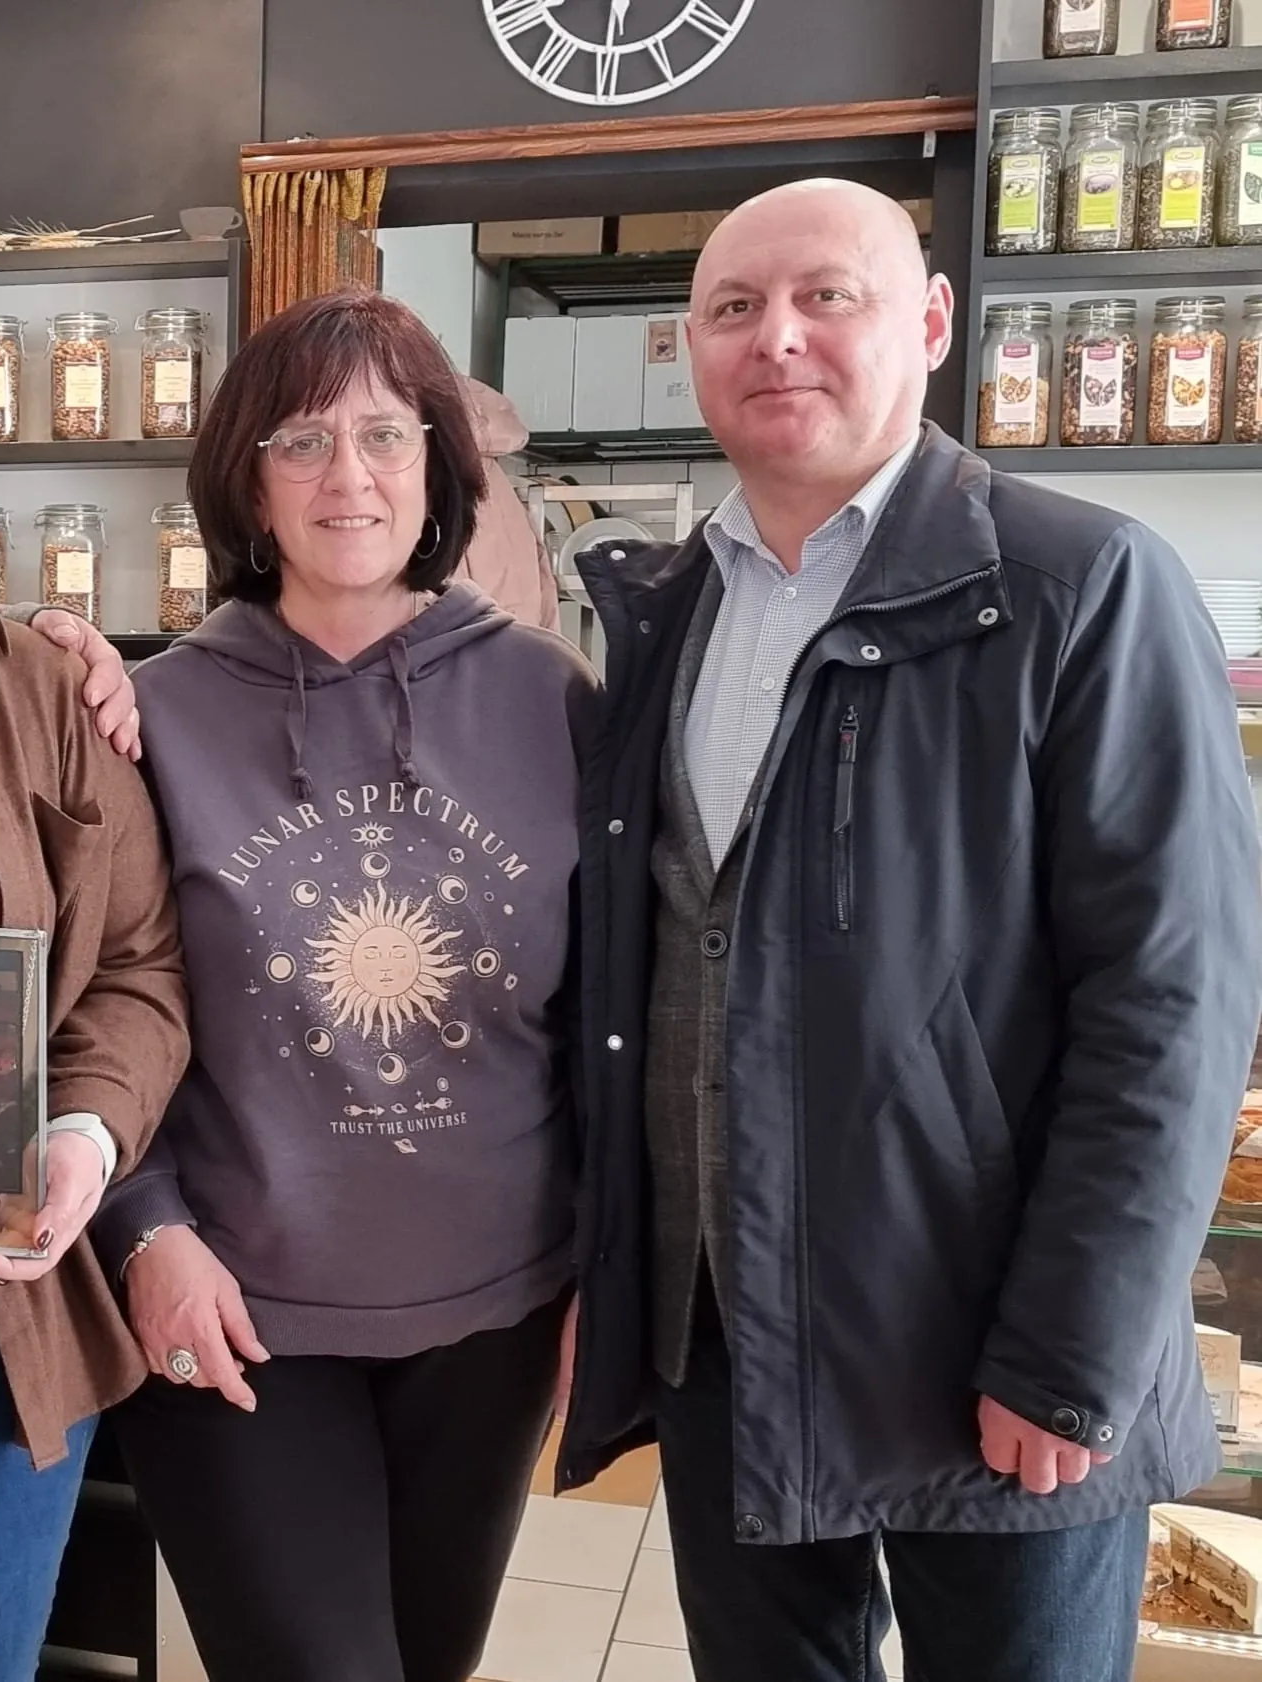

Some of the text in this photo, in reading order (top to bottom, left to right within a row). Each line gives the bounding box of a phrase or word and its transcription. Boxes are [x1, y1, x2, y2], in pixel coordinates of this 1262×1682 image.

[218, 781, 530, 887] LUNAR SPECTRUM
[330, 1111, 467, 1135] TRUST THE UNIVERSE
